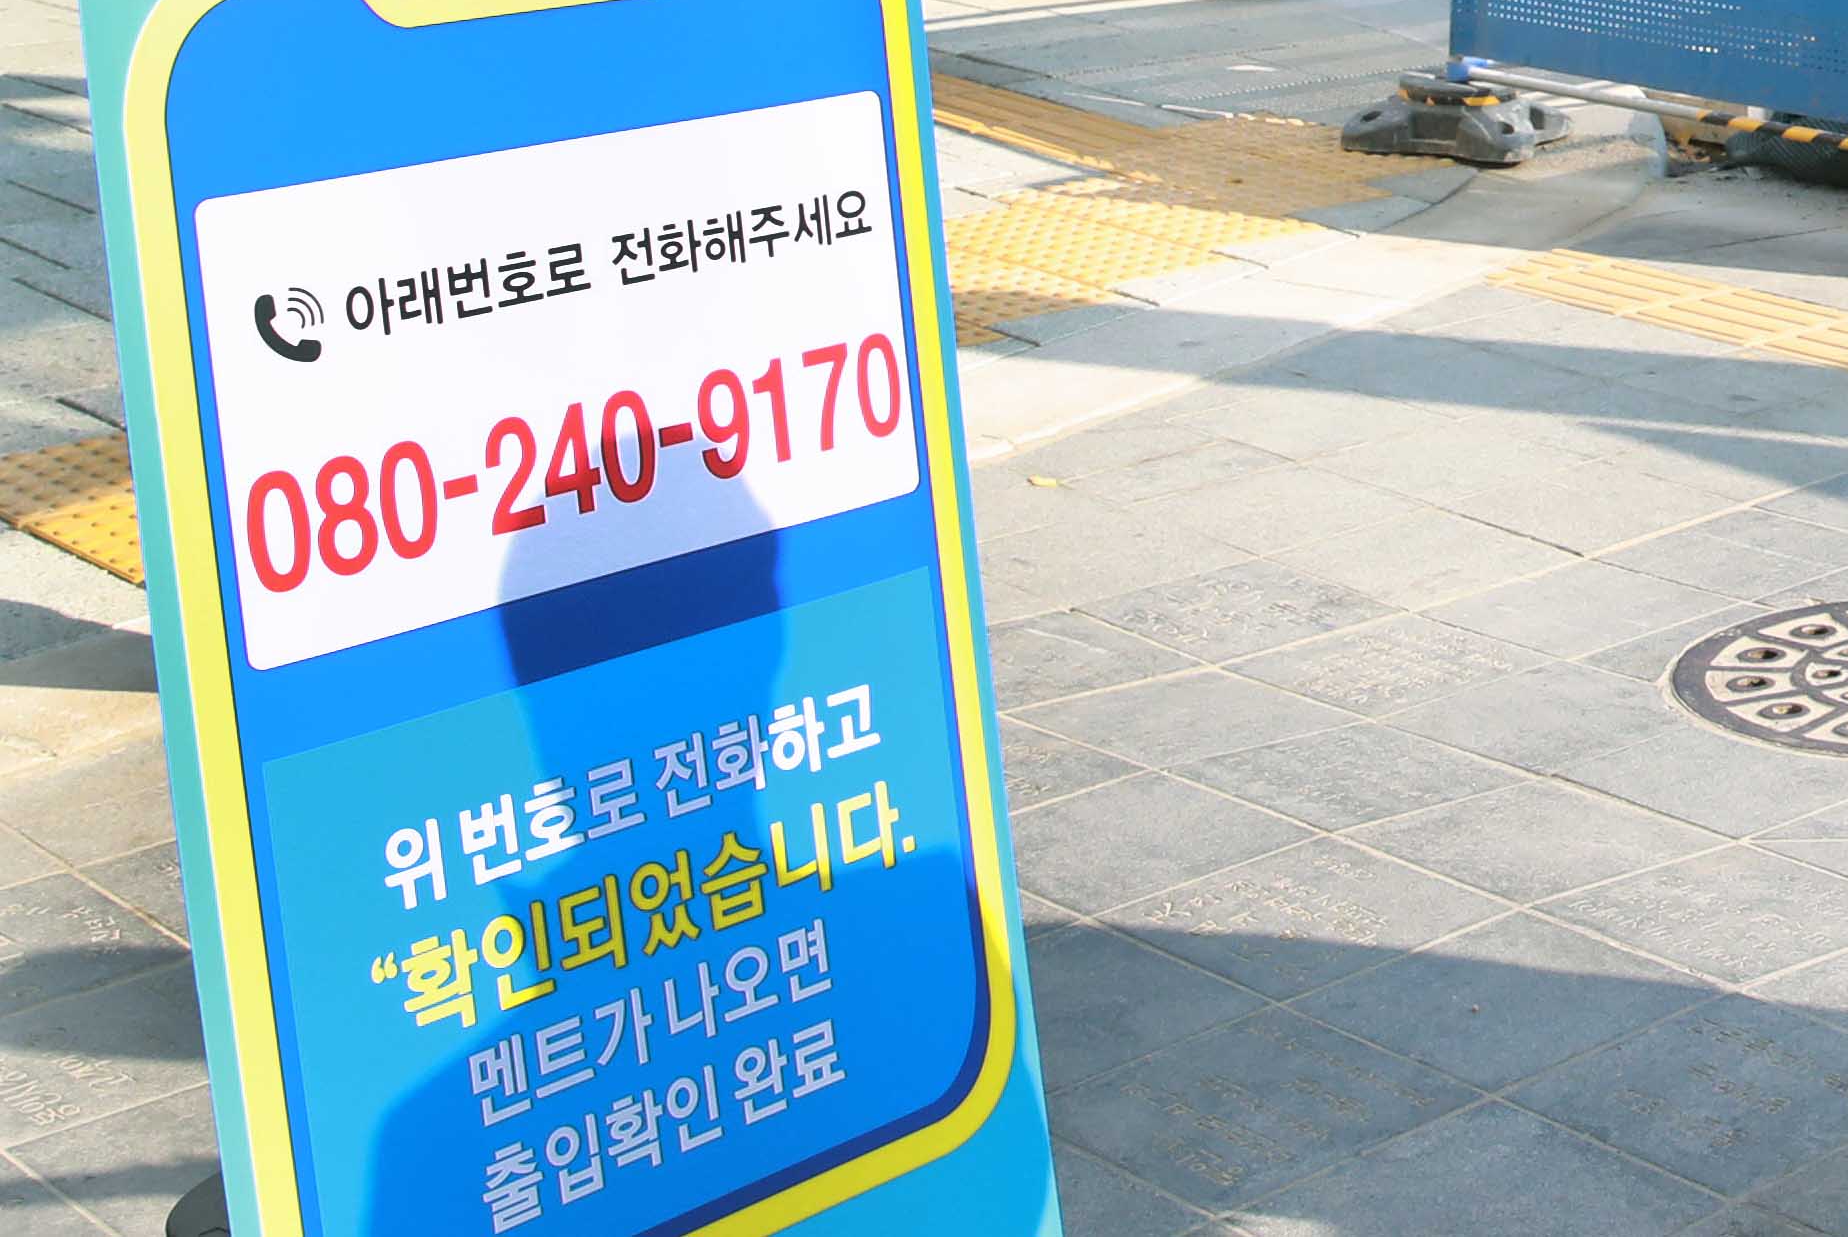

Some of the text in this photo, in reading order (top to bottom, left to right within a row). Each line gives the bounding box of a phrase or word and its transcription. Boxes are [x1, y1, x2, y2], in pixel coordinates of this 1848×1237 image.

[346, 191, 873, 336] 아래번호로 전화해주세요
[245, 333, 902, 593] 080-240-9170
[384, 683, 881, 910] 위 번호로 전화하고
[470, 919, 832, 1128] 멘트가 나오면
[482, 1021, 846, 1234] 출입확인 완료
